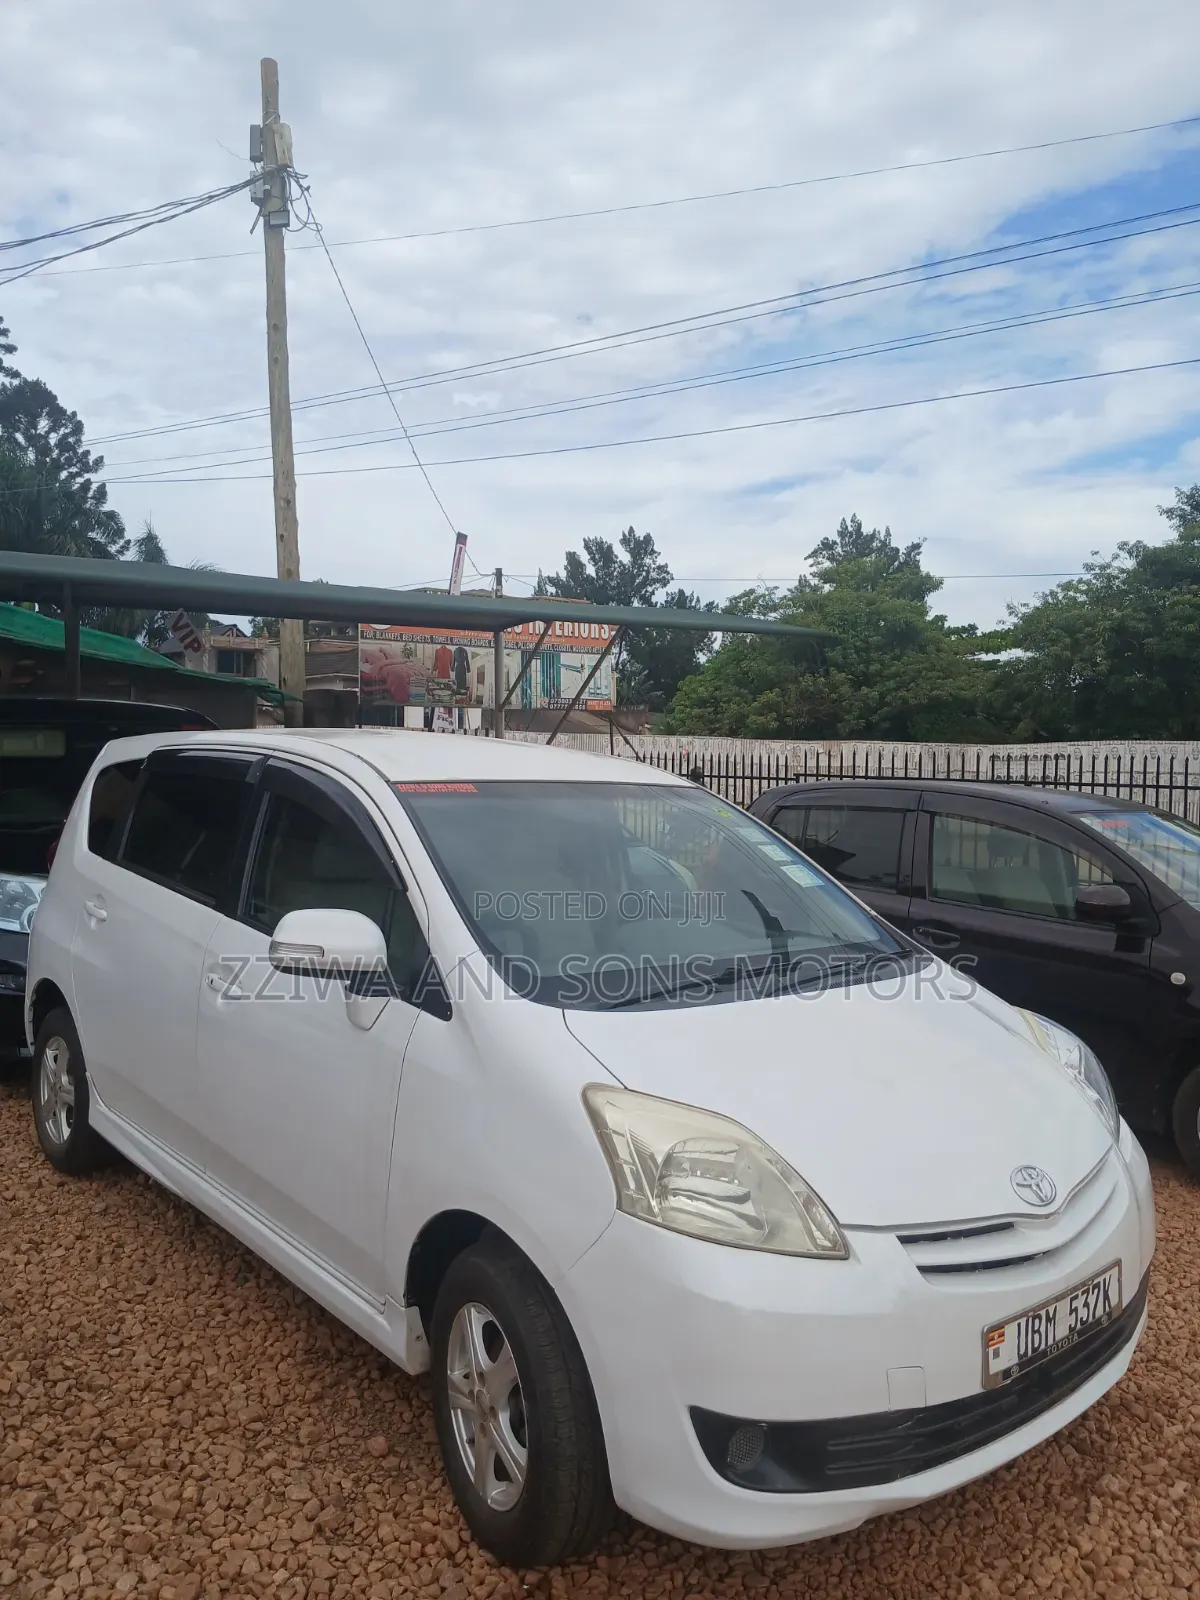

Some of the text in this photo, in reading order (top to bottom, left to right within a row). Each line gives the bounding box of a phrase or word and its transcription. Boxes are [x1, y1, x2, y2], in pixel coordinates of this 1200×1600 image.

[171, 611, 202, 653] VIP
[402, 633, 413, 641] BED
[1016, 1273, 1112, 1362] UBM 537K
[1046, 1332, 1079, 1355] TOYOTA
